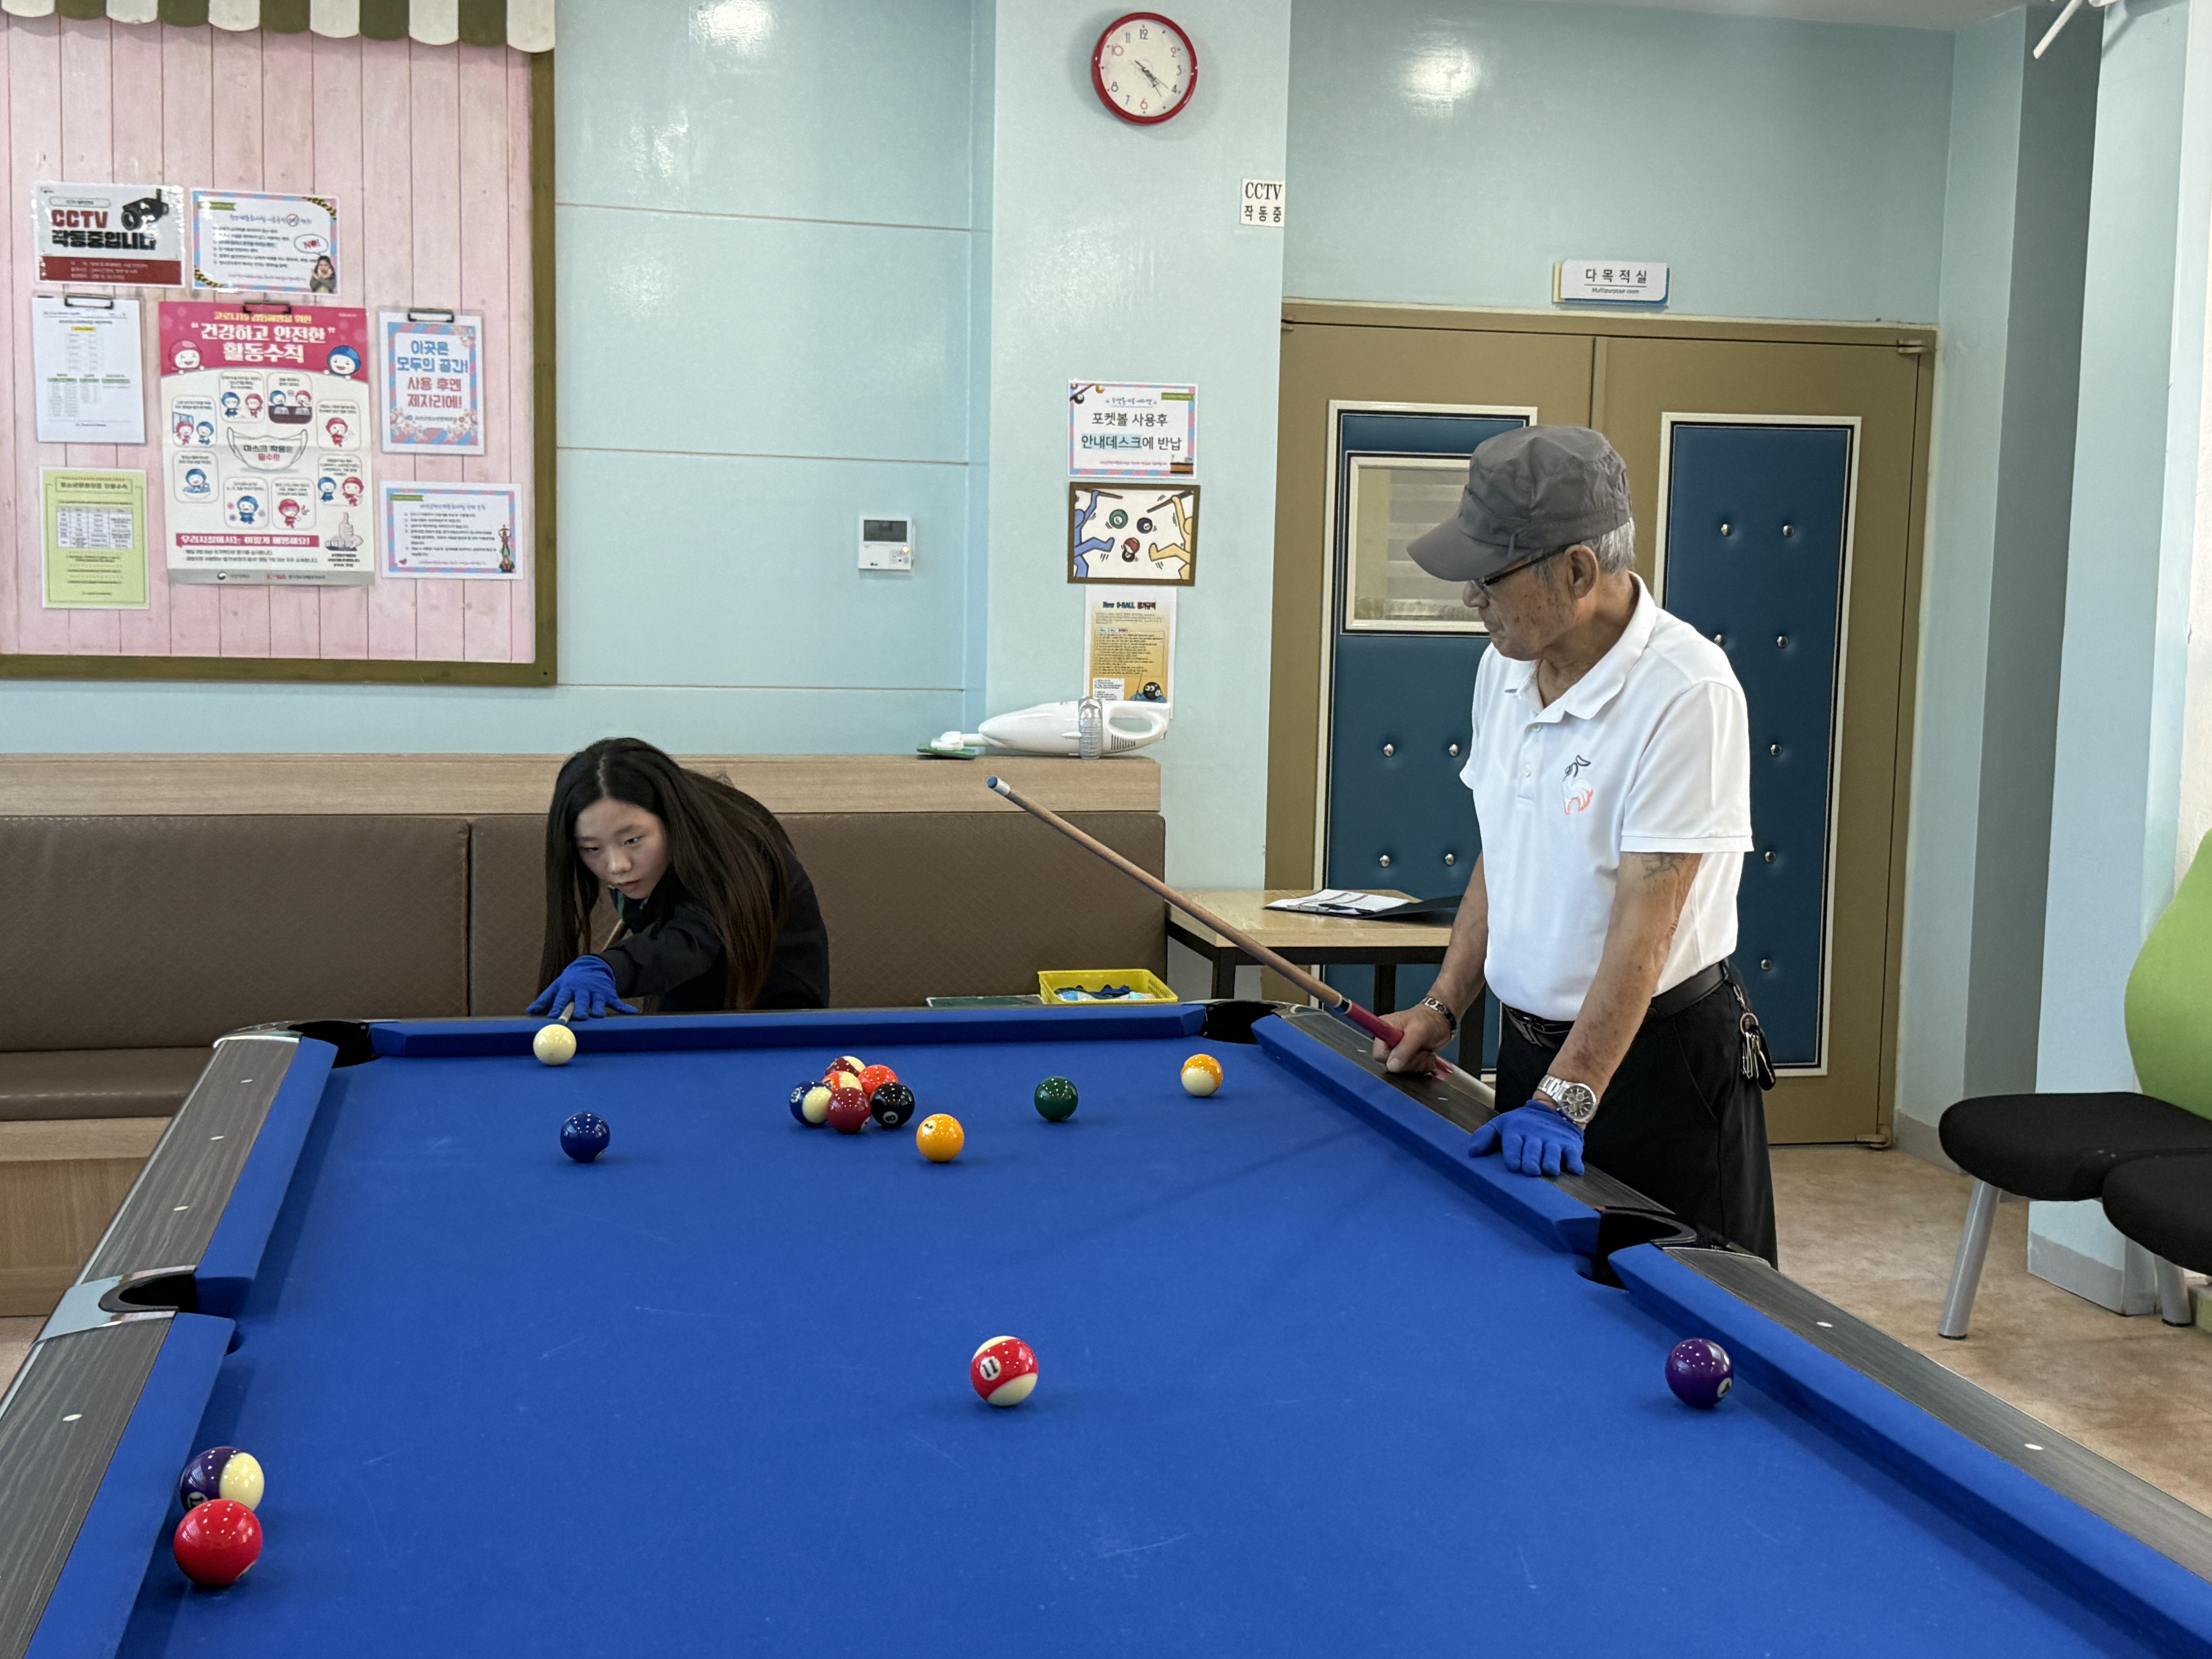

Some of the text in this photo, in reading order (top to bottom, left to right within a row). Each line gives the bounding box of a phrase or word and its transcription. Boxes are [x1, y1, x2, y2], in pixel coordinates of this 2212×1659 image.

[1126, 32, 1130, 43] 11
[1140, 29, 1148, 40] 12
[1111, 45, 1124, 56] 10
[1176, 65, 1182, 76] 3
[1111, 81, 1119, 93] 8
[1171, 84, 1177, 93] 4
[1125, 94, 1130, 105] 7
[1140, 98, 1148, 110] 6
[1245, 182, 1282, 200] CCTV
[51, 210, 108, 228] CCTV
[223, 342, 304, 363] 활동수칙
[410, 340, 449, 356] 이곳은
[397, 357, 435, 372] 모두의
[407, 377, 433, 391] 사용
[407, 393, 462, 409] 제자리에!
[1092, 412, 1168, 427] 포켓볼 사용후
[1081, 435, 1182, 451] 안내데스크에 반납
[982, 1358, 999, 1378] 11
